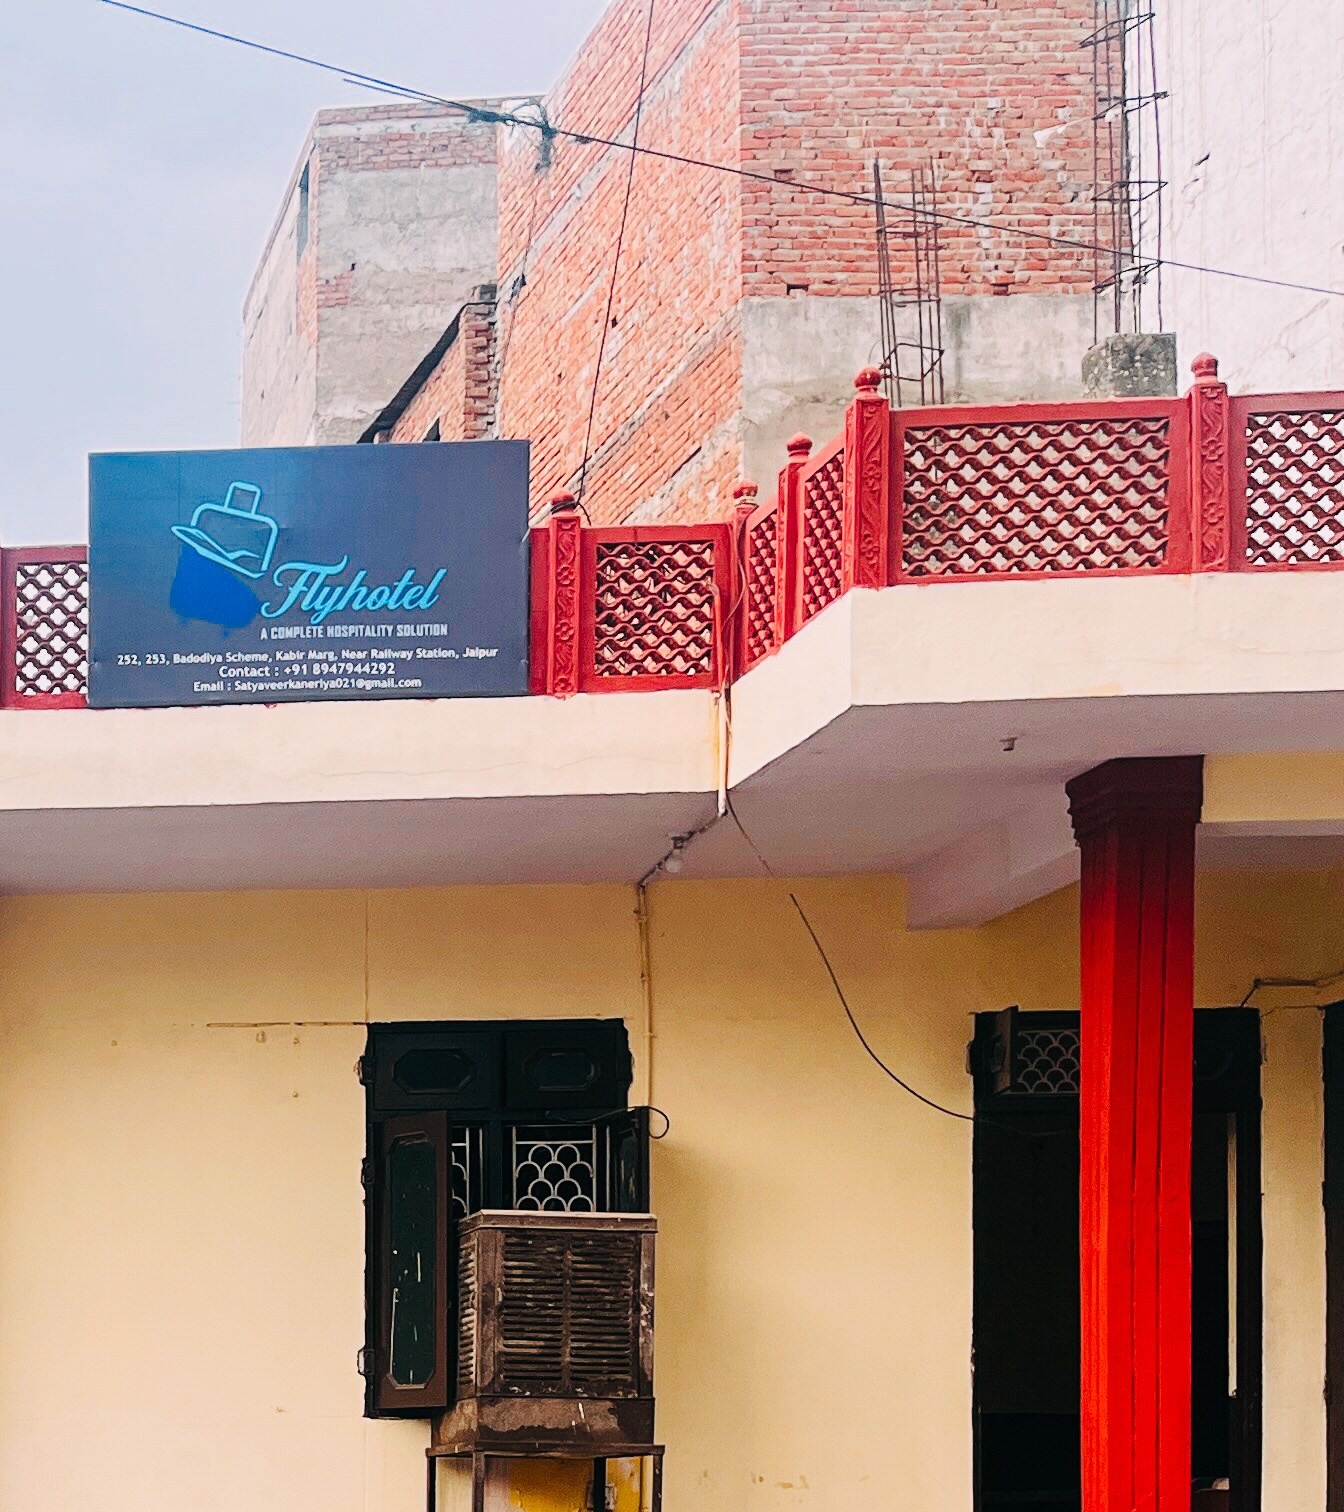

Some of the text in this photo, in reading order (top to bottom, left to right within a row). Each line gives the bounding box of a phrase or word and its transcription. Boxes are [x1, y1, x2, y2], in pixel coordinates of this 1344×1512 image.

[260, 555, 447, 625] Flyhotel
[260, 623, 448, 641] A COMPLETE HOSPITALITY SOLUTION
[117, 646, 499, 666] 252, 253, Badodiya Scheme, Kabir Marg, Near Railway Station, Jaipur
[218, 665, 271, 678] Contact
[283, 663, 308, 676] +91
[312, 662, 396, 676] 8947944292
[193, 679, 224, 692] Email
[234, 677, 422, 694] Satyaveerkaneriya021@gmail.com
